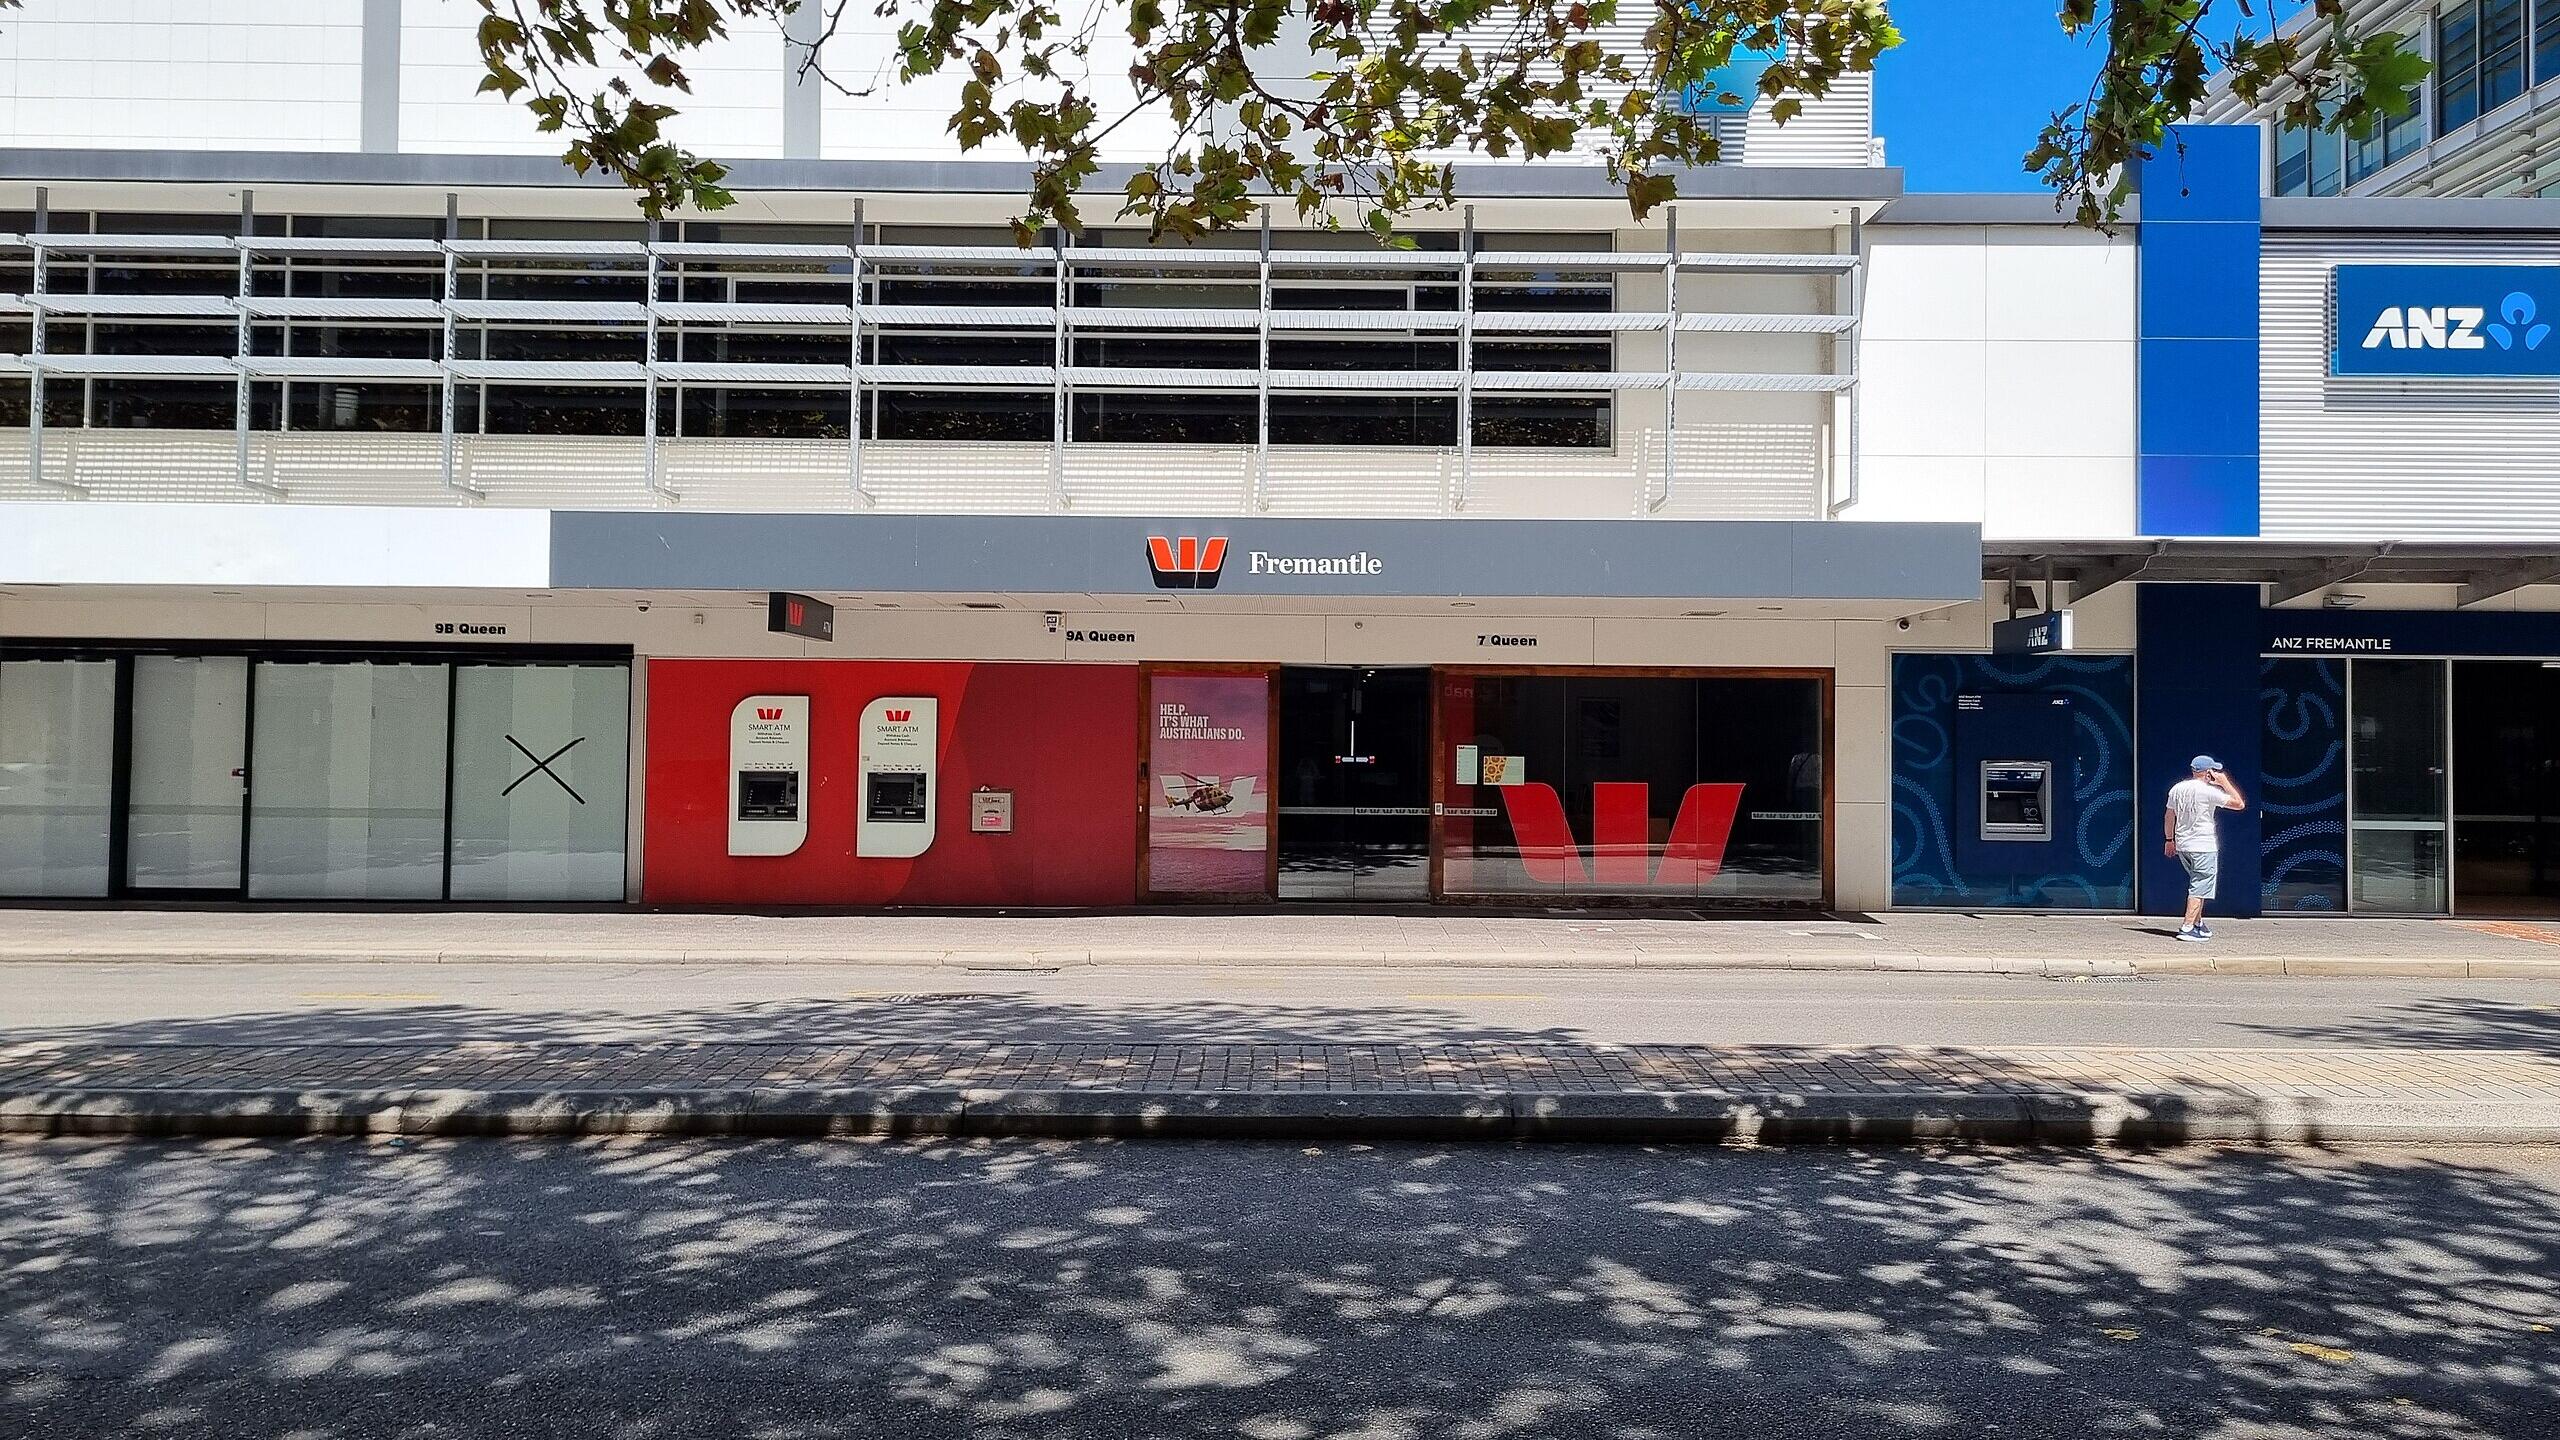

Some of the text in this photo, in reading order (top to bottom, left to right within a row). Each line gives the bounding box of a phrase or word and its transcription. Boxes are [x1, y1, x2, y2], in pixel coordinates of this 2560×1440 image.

[2362, 307, 2485, 349] ANZ
[1249, 551, 1383, 575] Fremantle
[434, 623, 506, 635] 9B Queen
[1066, 630, 1135, 642] 9A Queen
[1477, 635, 1537, 646] 7 Queen
[2026, 626, 2048, 648] ANZ
[2272, 637, 2392, 650] ANZ FREMANTLE
[1160, 703, 1188, 716] HELP.
[748, 723, 791, 731] SMART ATM
[1180, 715, 1209, 728] WHAT
[876, 725, 919, 733] SMART ATM
[1160, 727, 1246, 741] AUSTRALIANS DO.
